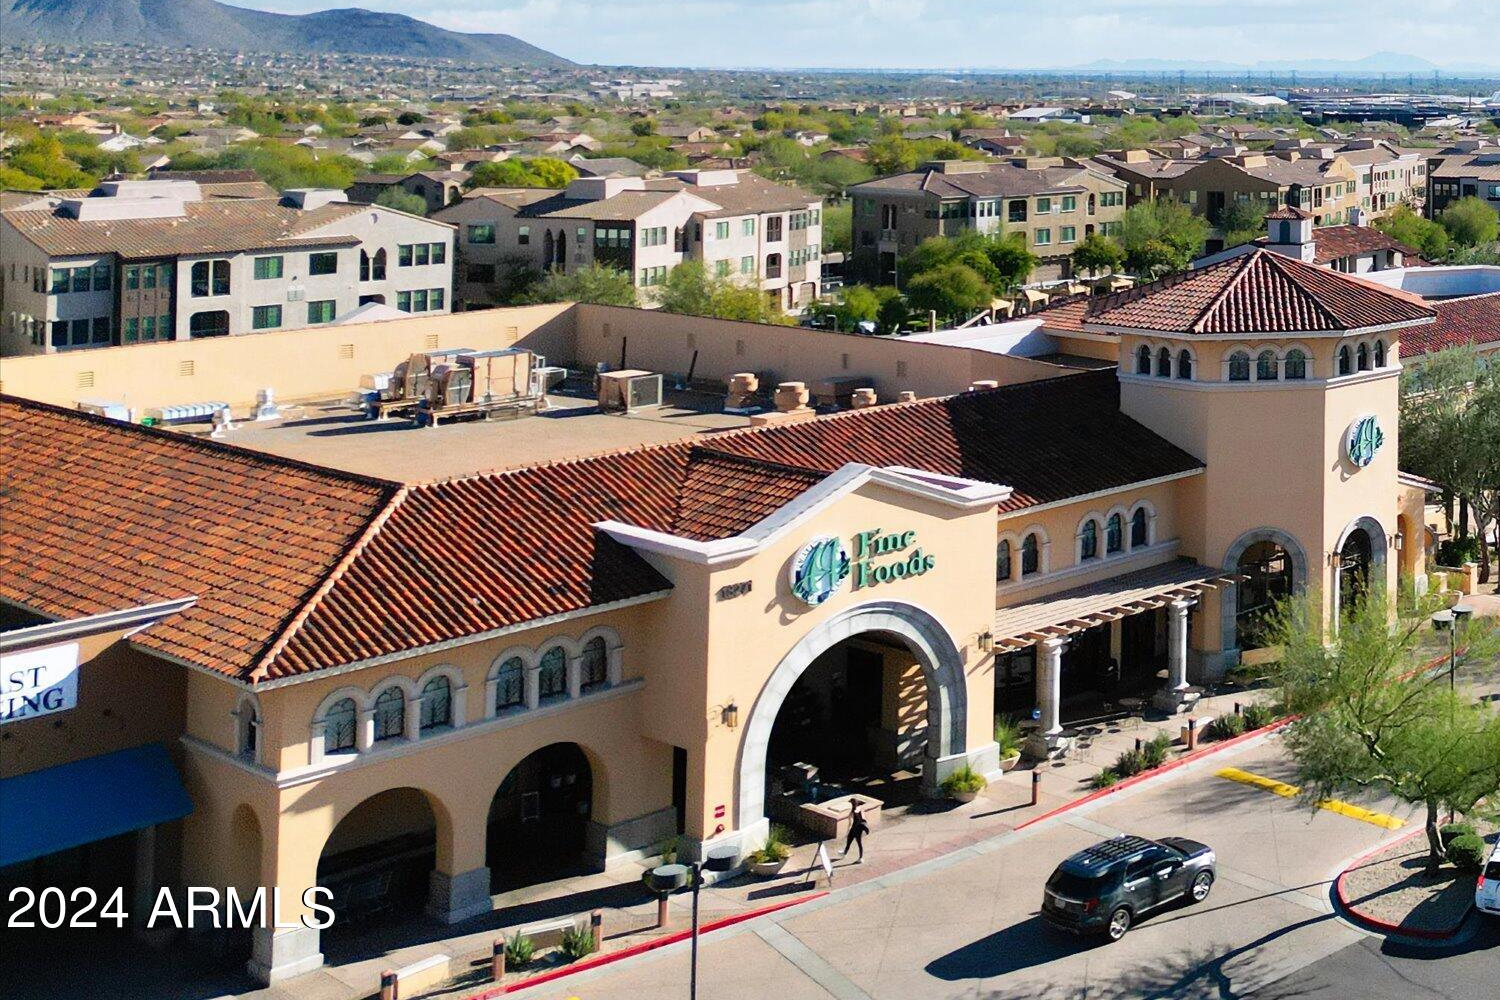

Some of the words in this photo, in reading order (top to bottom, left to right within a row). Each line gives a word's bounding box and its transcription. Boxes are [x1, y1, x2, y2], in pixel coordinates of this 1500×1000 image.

[859, 528, 916, 557] Fine
[859, 547, 936, 588] Foods
[0, 666, 47, 694] ST
[0, 687, 64, 719] ING
